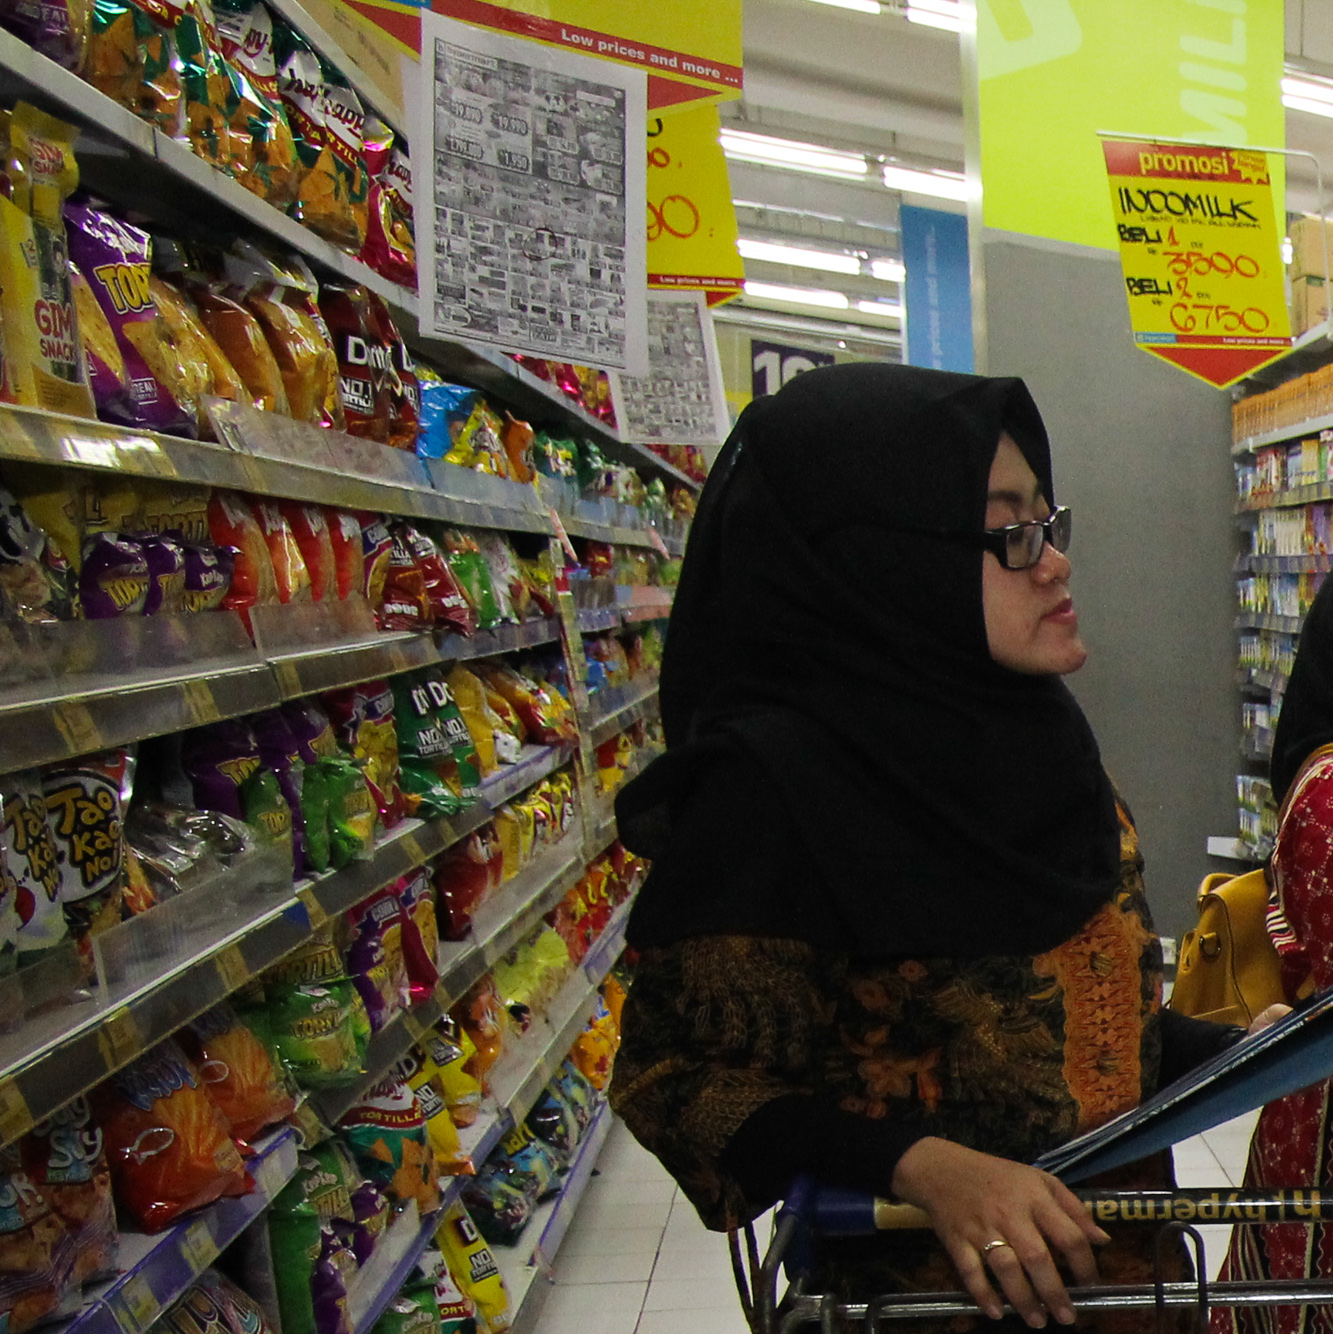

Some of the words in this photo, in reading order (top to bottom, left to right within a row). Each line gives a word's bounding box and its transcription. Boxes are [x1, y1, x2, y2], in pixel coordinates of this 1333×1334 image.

[561, 28, 593, 47] Low
[598, 39, 645, 60] prices
[650, 52, 677, 69] and
[682, 61, 720, 79] more
[1139, 152, 1230, 174] promosi
[1118, 224, 1162, 243] BELI
[1168, 227, 1179, 246] 1
[1163, 252, 1260, 278] 3590
[1126, 278, 1172, 296] BELI
[34, 300, 72, 335] GIM
[1170, 303, 1269, 333] 6750
